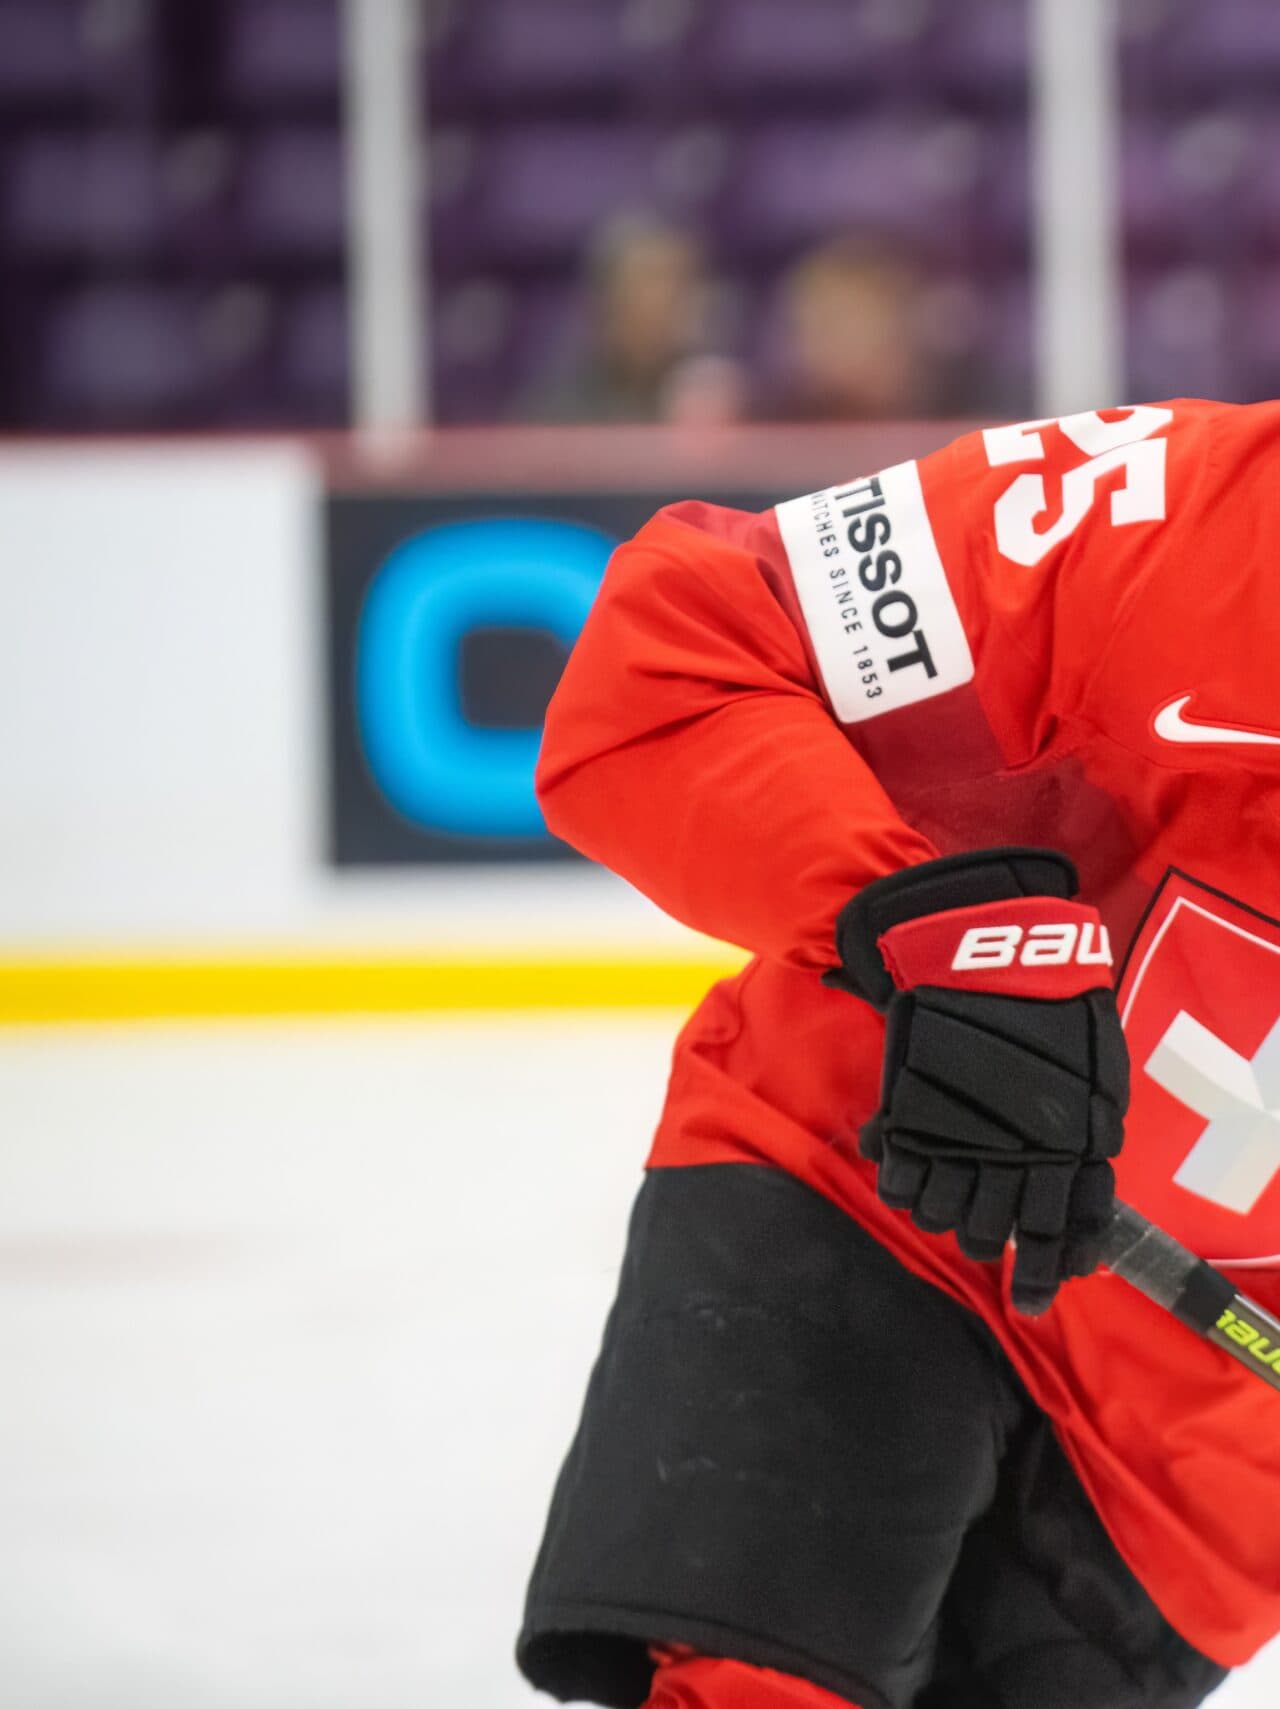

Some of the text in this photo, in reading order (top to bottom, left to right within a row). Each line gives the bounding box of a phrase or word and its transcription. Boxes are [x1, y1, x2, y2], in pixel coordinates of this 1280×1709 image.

[829, 567, 863, 635] SINCE
[853, 645, 883, 699] 1853
[834, 476, 938, 680] TISSOT
